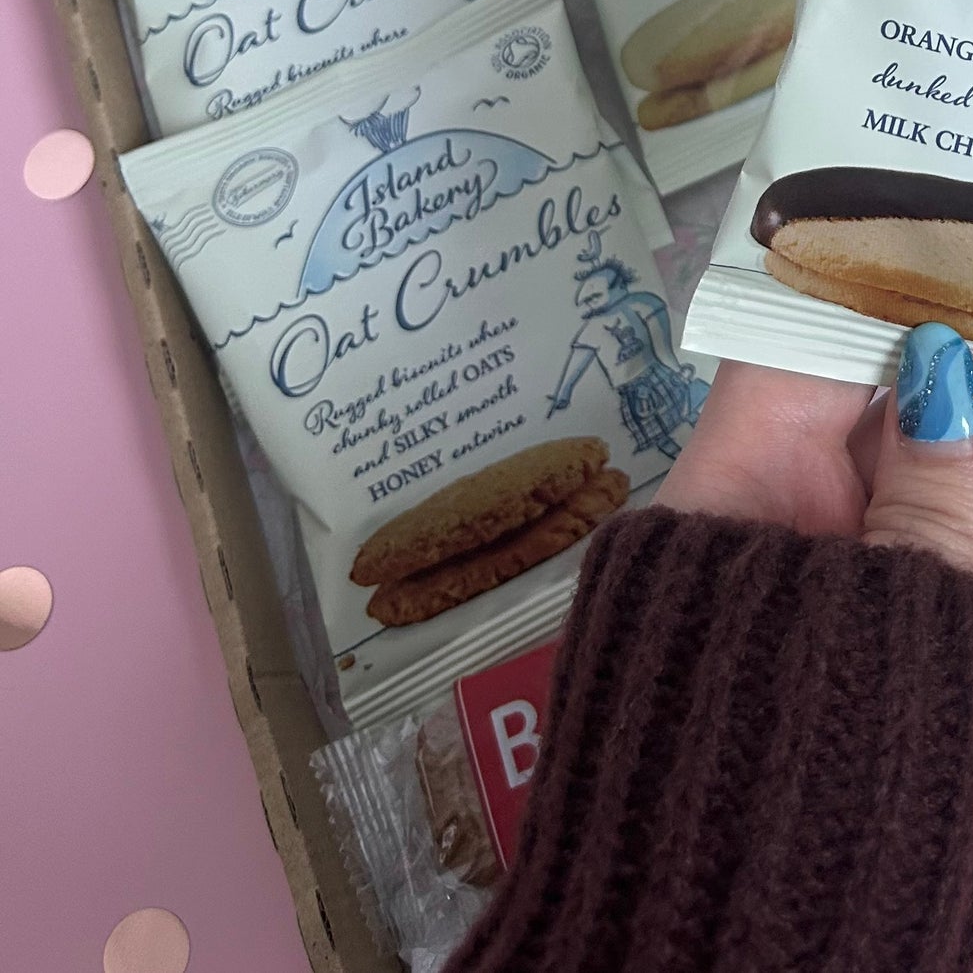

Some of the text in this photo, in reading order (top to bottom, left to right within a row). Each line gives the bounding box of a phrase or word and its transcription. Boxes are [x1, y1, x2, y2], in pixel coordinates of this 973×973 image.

[183, 13, 281, 87] Oat
[205, 27, 409, 122] Rugged biscuits where
[872, 62, 973, 112] dunked
[861, 107, 931, 146] MILK
[340, 158, 499, 259] Bakery
[342, 138, 473, 221] Island
[269, 303, 381, 398] Oat
[395, 185, 623, 331] Crumbles
[303, 316, 520, 437] Rugged biscuits where
[331, 344, 518, 456] chunky rolled OATS
[352, 375, 520, 479] and SILKY smooth
[367, 412, 528, 505] HONEY entwine
